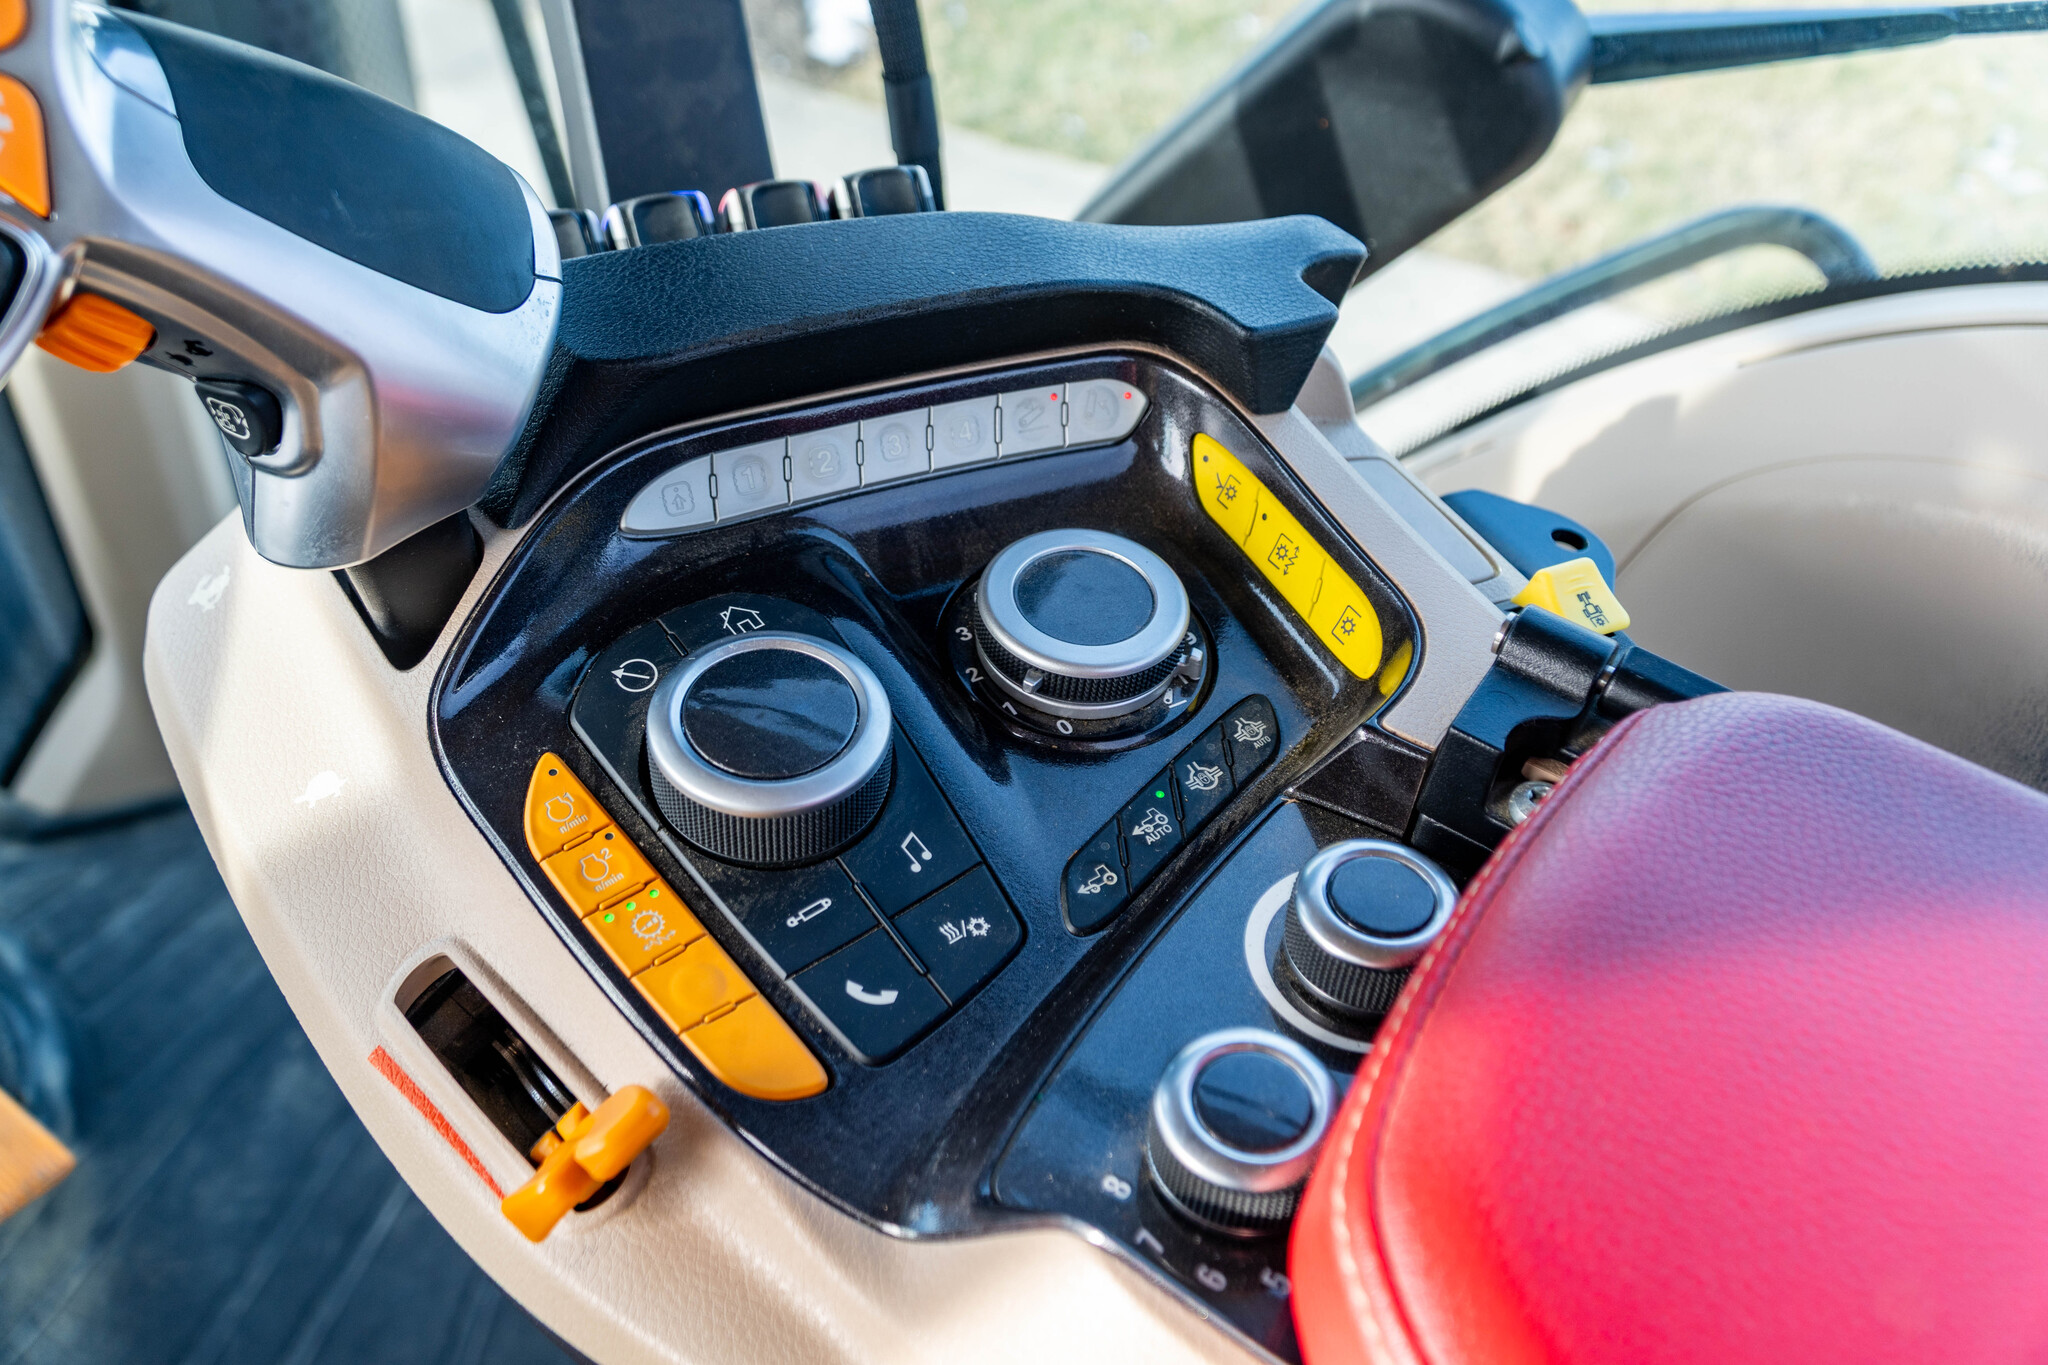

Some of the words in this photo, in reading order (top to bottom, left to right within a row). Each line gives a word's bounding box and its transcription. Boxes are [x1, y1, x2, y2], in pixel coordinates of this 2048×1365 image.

[959, 421, 972, 442] 4
[891, 433, 903, 457] 3
[817, 450, 834, 474] 2
[740, 465, 756, 490] 1
[955, 626, 973, 641] 3
[965, 667, 984, 683] 2
[1002, 701, 1018, 716] 1
[1056, 719, 1073, 735] 0
[1253, 735, 1272, 750] AUTO
[563, 792, 574, 803] 1
[559, 814, 588, 834] n/min
[1145, 824, 1173, 845] AUTO
[600, 847, 613, 860] 2
[594, 873, 624, 892] n/min
[1102, 1174, 1132, 1200] 8
[1135, 1227, 1164, 1255] 7
[1196, 1264, 1227, 1291] 6
[1260, 1267, 1291, 1296] 5
